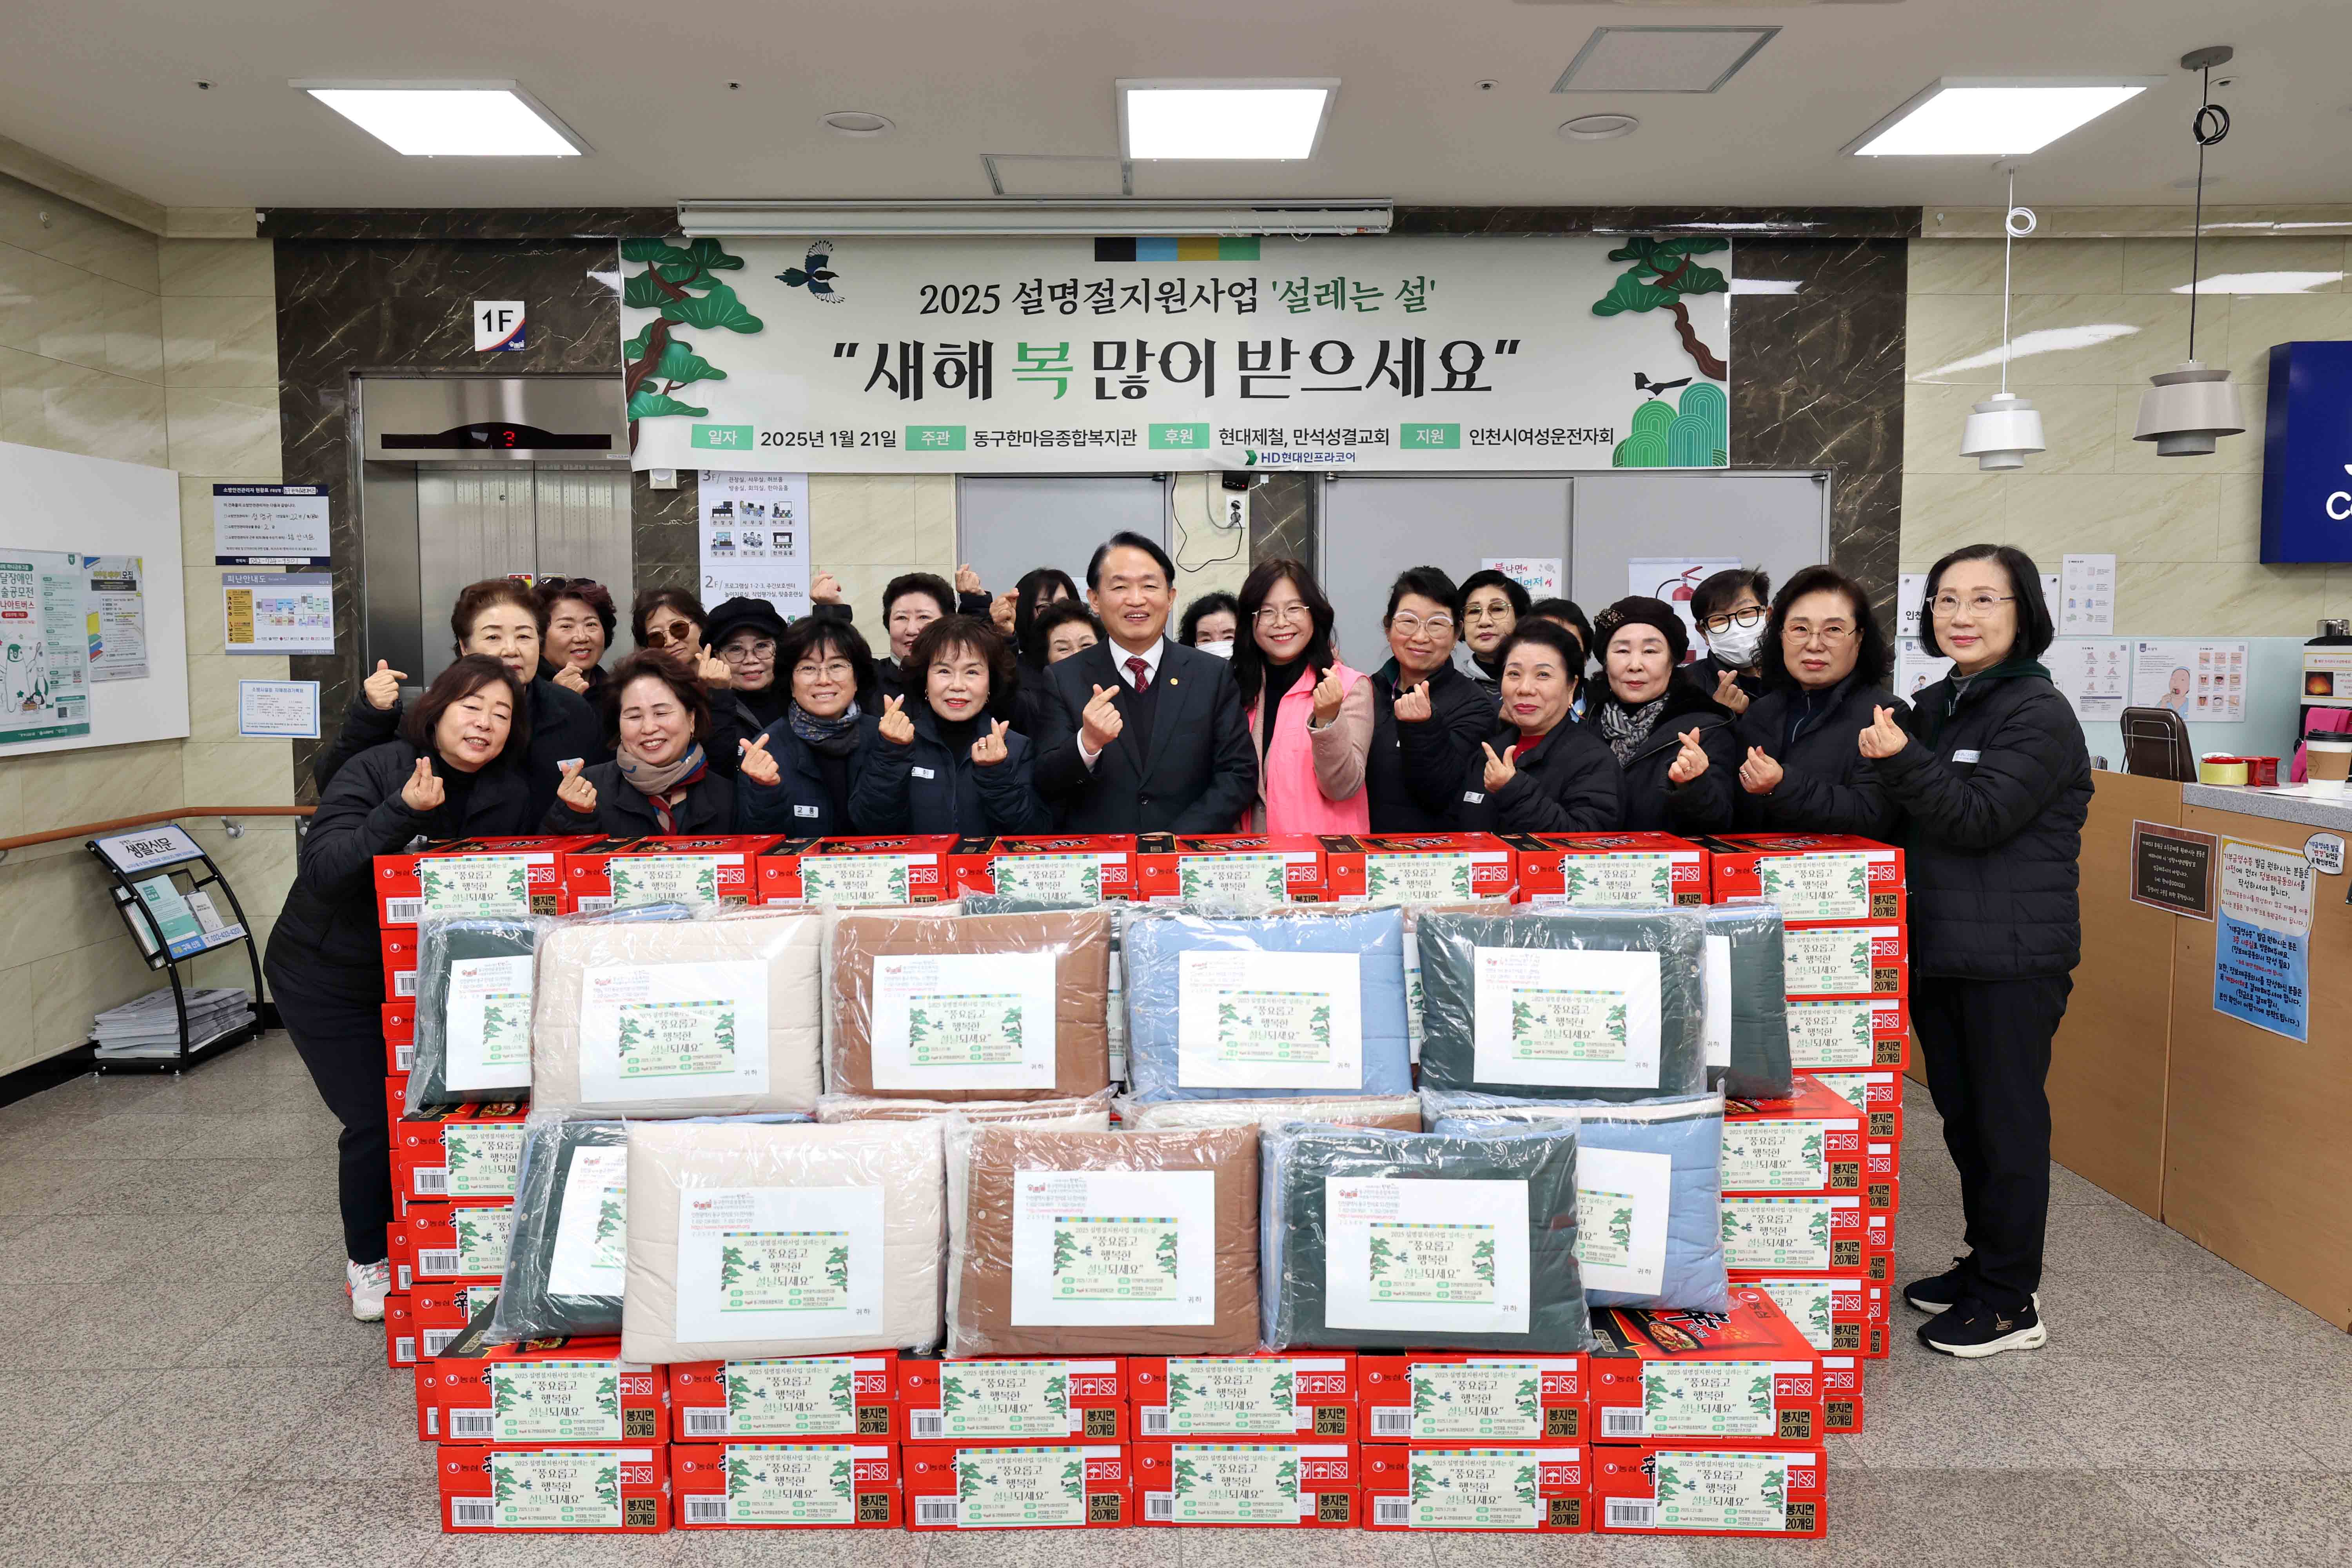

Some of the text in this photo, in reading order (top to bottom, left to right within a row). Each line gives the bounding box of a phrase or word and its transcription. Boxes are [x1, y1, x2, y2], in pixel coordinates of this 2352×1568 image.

[920, 275, 1436, 315] 2025 설명절지원사업 '설레는 설'
[482, 309, 513, 332] 1F
[833, 336, 1521, 401] "새해 복 많이 받으세요"
[708, 430, 737, 445] 일자
[760, 430, 897, 448] 2025년 1월 21일
[922, 430, 950, 446] 주관
[973, 429, 1137, 447] 동구한마음종합복지관
[1164, 428, 1194, 444] 후원
[1219, 428, 1389, 448] 현대제철, 만석성결교회
[1416, 429, 1444, 444] 지원
[1469, 428, 1613, 445] 인천시여성운전자회
[1261, 452, 1356, 463] HD현대인프라코어
[2326, 491, 2352, 520] C
[122, 571, 133, 580] 모집
[227, 575, 267, 584] 피난안내도
[1, 586, 34, 598] 술공모전
[125, 838, 176, 858] 생활신문
[2223, 853, 2308, 879] 기부금영수증 발급 원하시는 분들은
[2225, 865, 2305, 891] 사전에 먼저 정보제공동의서를
[2238, 878, 2268, 892] 작성하셔야
[1873, 895, 1897, 905] 봉지면
[1873, 907, 1897, 916] 20개입
[2266, 956, 2278, 966] 작성
[541, 1393, 572, 1405] 행복한
[1693, 1390, 1724, 1401] 행복한
[626, 1409, 655, 1423] 봉지면
[859, 1406, 887, 1419] 봉지면
[1087, 1409, 1115, 1421] 봉지면
[1317, 1407, 1345, 1419] 봉지면
[1548, 1409, 1577, 1421] 봉지면
[1781, 1411, 1810, 1423] 봉지면
[626, 1424, 655, 1437] 20개입
[859, 1421, 887, 1433] 20개입
[1087, 1424, 1115, 1436] 20개입
[1317, 1421, 1345, 1433] 20개입
[1548, 1424, 1577, 1435] 20개입
[1781, 1425, 1810, 1438] 20개입
[627, 1499, 655, 1512] 봉지면
[860, 1494, 888, 1506] 봉지면
[1091, 1495, 1119, 1506] 봉지면
[1320, 1494, 1348, 1506] 봉지면
[1552, 1500, 1579, 1512] 봉지면
[860, 1508, 888, 1520] 20개입
[1091, 1509, 1119, 1521] 20개입
[1320, 1508, 1348, 1520] 20개입
[1787, 1504, 1814, 1516] 봉지면
[627, 1513, 655, 1526] 20개입
[1552, 1514, 1579, 1526] 20개입
[1786, 1518, 1814, 1530] 20개입
